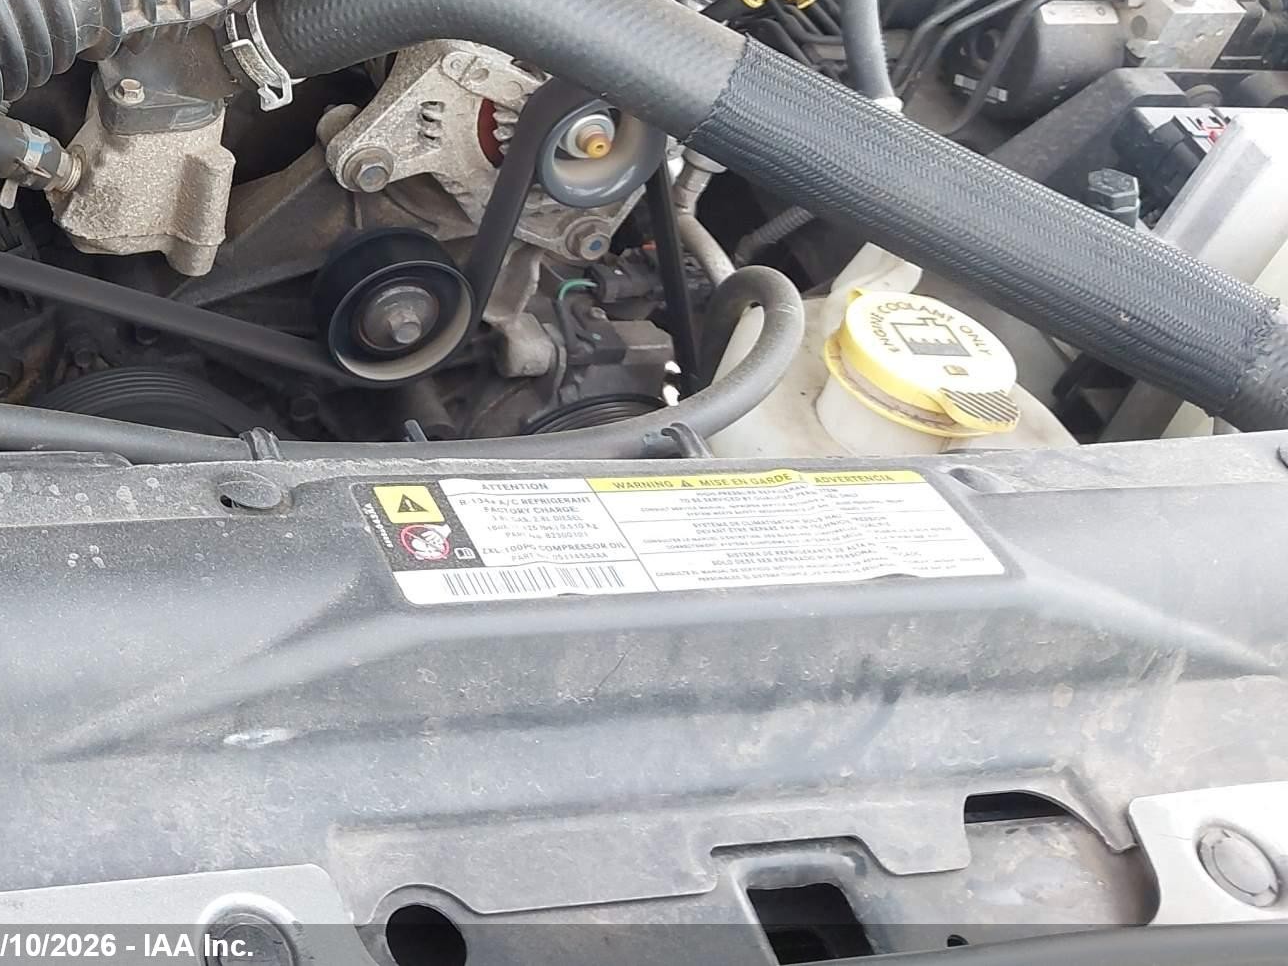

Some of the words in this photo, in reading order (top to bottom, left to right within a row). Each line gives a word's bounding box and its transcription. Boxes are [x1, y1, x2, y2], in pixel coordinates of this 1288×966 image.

[877, 301, 955, 322] COOLANT
[871, 311, 900, 353] ENGINE
[959, 325, 992, 356] ONLY
[481, 482, 549, 491] ATTENTION
[612, 480, 674, 489] WARNING
[699, 479, 728, 487] MISE
[730, 478, 748, 486] EN
[750, 473, 793, 485] GARDE
[814, 474, 895, 484] ADVERTENCIA
[520, 496, 591, 505] REFRIGERANT
[484, 506, 531, 514] FACTORY
[553, 514, 584, 522] DIESEL
[538, 542, 608, 553] COMPRESSOR
[609, 541, 627, 551] OIL
